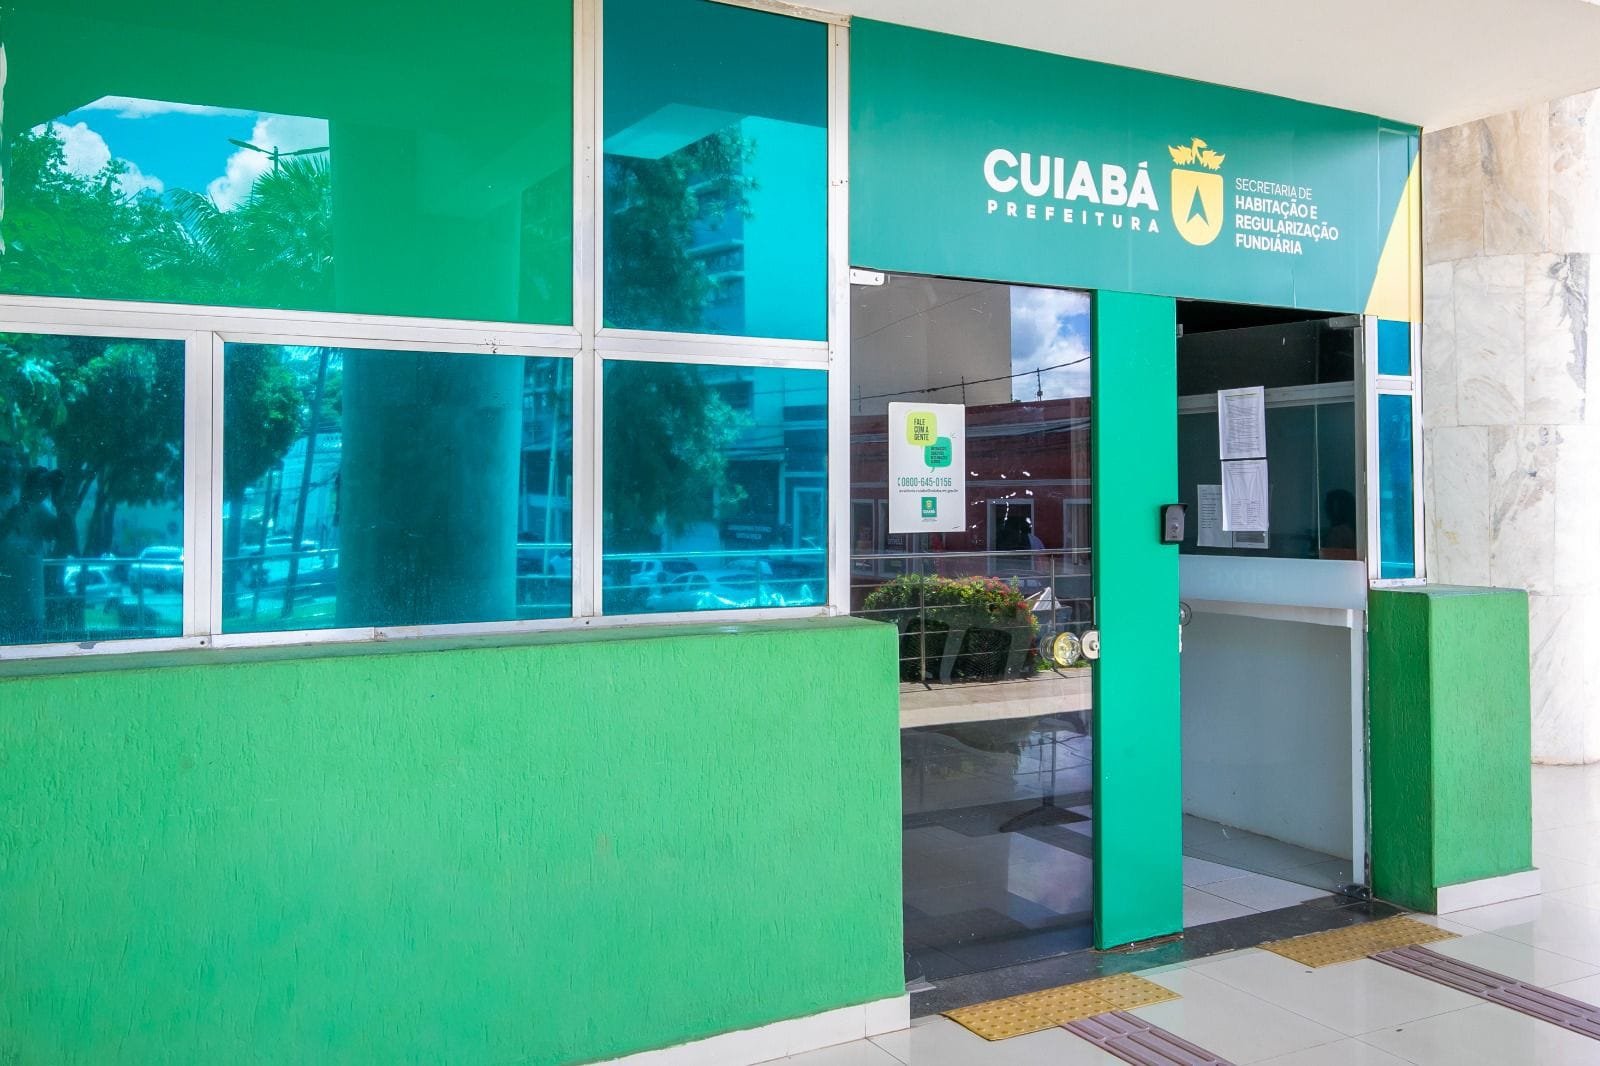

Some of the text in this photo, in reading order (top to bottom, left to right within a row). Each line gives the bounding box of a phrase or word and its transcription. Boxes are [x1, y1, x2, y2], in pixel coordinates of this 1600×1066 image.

[983, 148, 1160, 211] CUIABÁ
[1235, 177, 1313, 200] SECRETARIA DE
[987, 199, 1160, 233] PREFEITURA
[1235, 195, 1318, 219] HABITAÇÃO E
[1235, 214, 1339, 242] REGULARIZAÇÃO
[1235, 233, 1303, 255] FUNDIÁRIA
[913, 418, 926, 426] FALE
[913, 433, 929, 441] GENTE
[901, 477, 952, 487] 0800-645-0156
